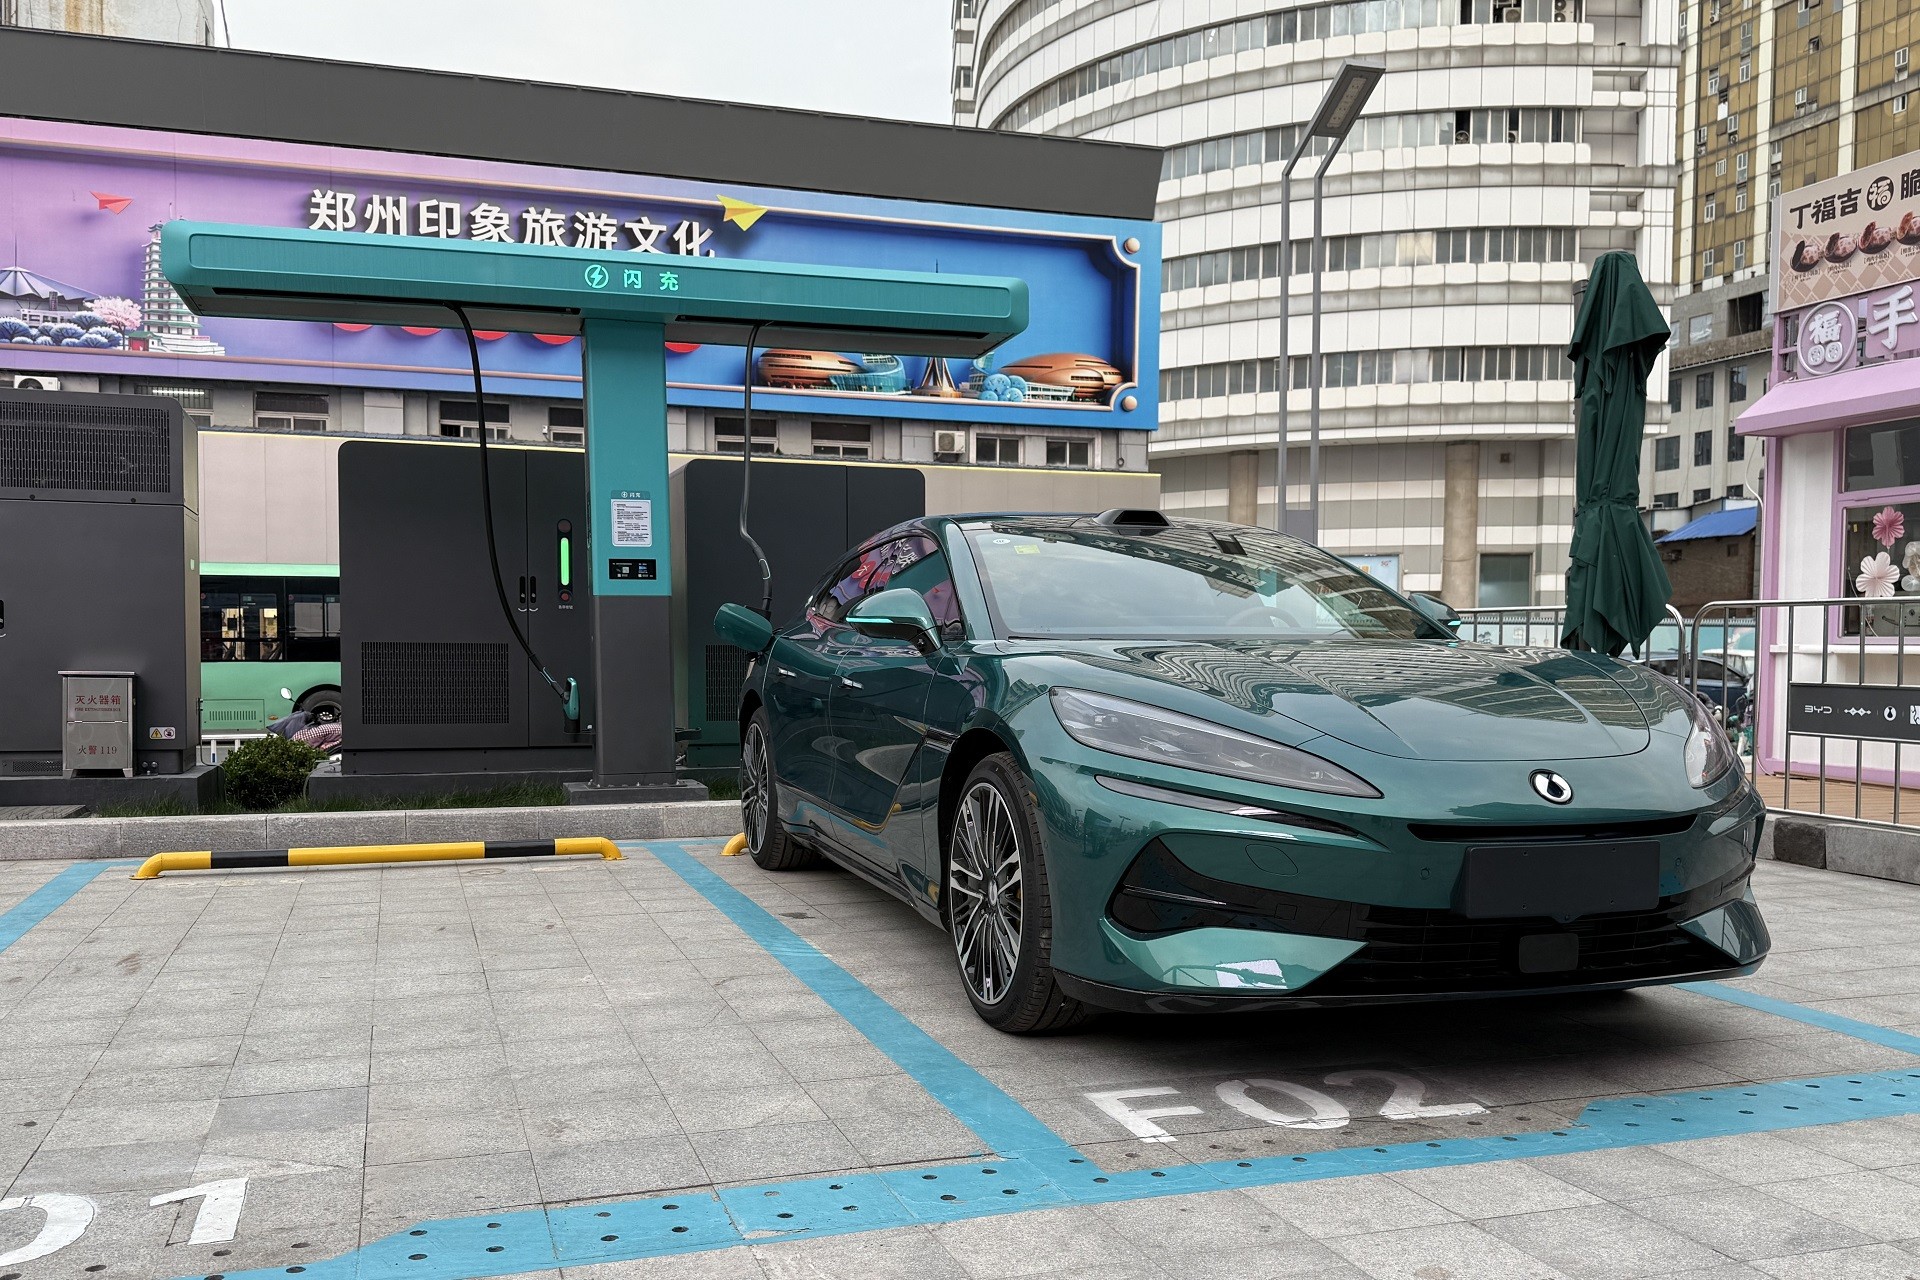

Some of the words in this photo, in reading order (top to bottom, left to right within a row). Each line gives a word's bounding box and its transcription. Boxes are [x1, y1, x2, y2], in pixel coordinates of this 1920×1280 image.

[309, 188, 716, 258] 郑州印象旅游文化
[1789, 187, 1862, 230] 丁福吉
[623, 268, 680, 291] 闪充
[1867, 285, 1919, 350] 手
[75, 695, 121, 705] 灭火器箱
[1804, 704, 1833, 714] BYD
[78, 745, 98, 755] 火警
[100, 745, 117, 755] 119
[1085, 1069, 1491, 1143] F02
